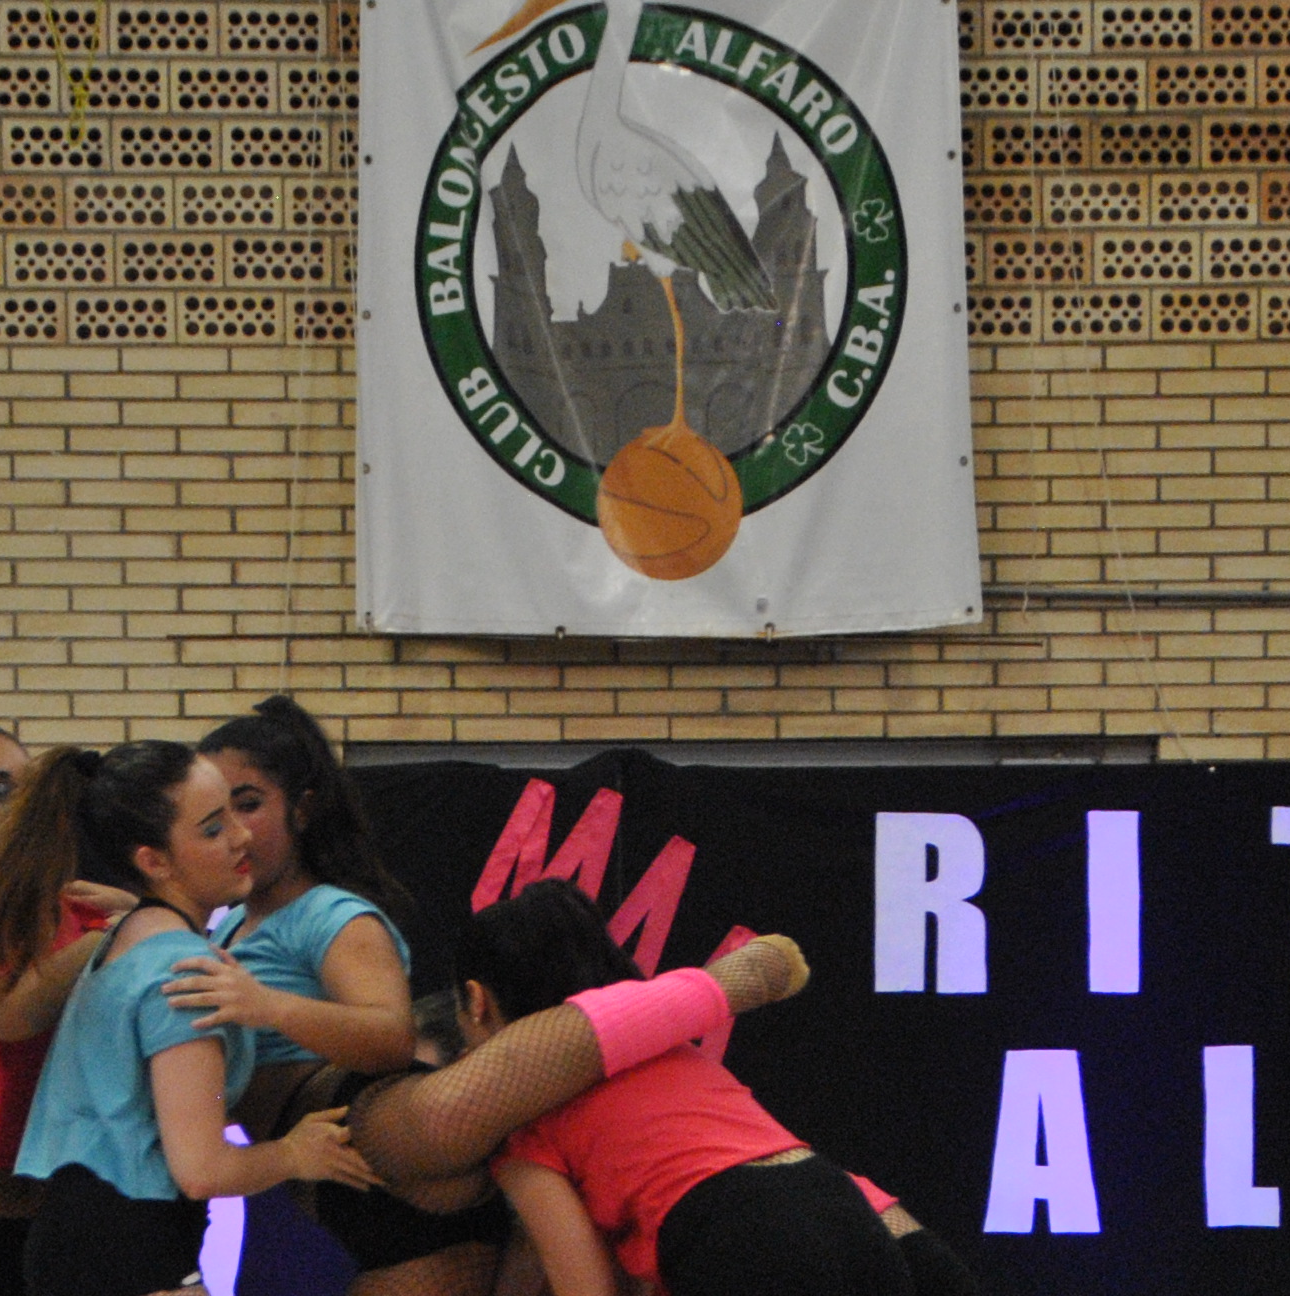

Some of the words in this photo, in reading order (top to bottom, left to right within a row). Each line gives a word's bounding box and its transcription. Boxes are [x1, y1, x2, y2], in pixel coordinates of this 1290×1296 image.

[674, 20, 858, 154] ALFARO
[826, 269, 896, 408] C.B.A.
[458, 366, 566, 486] CLUB
